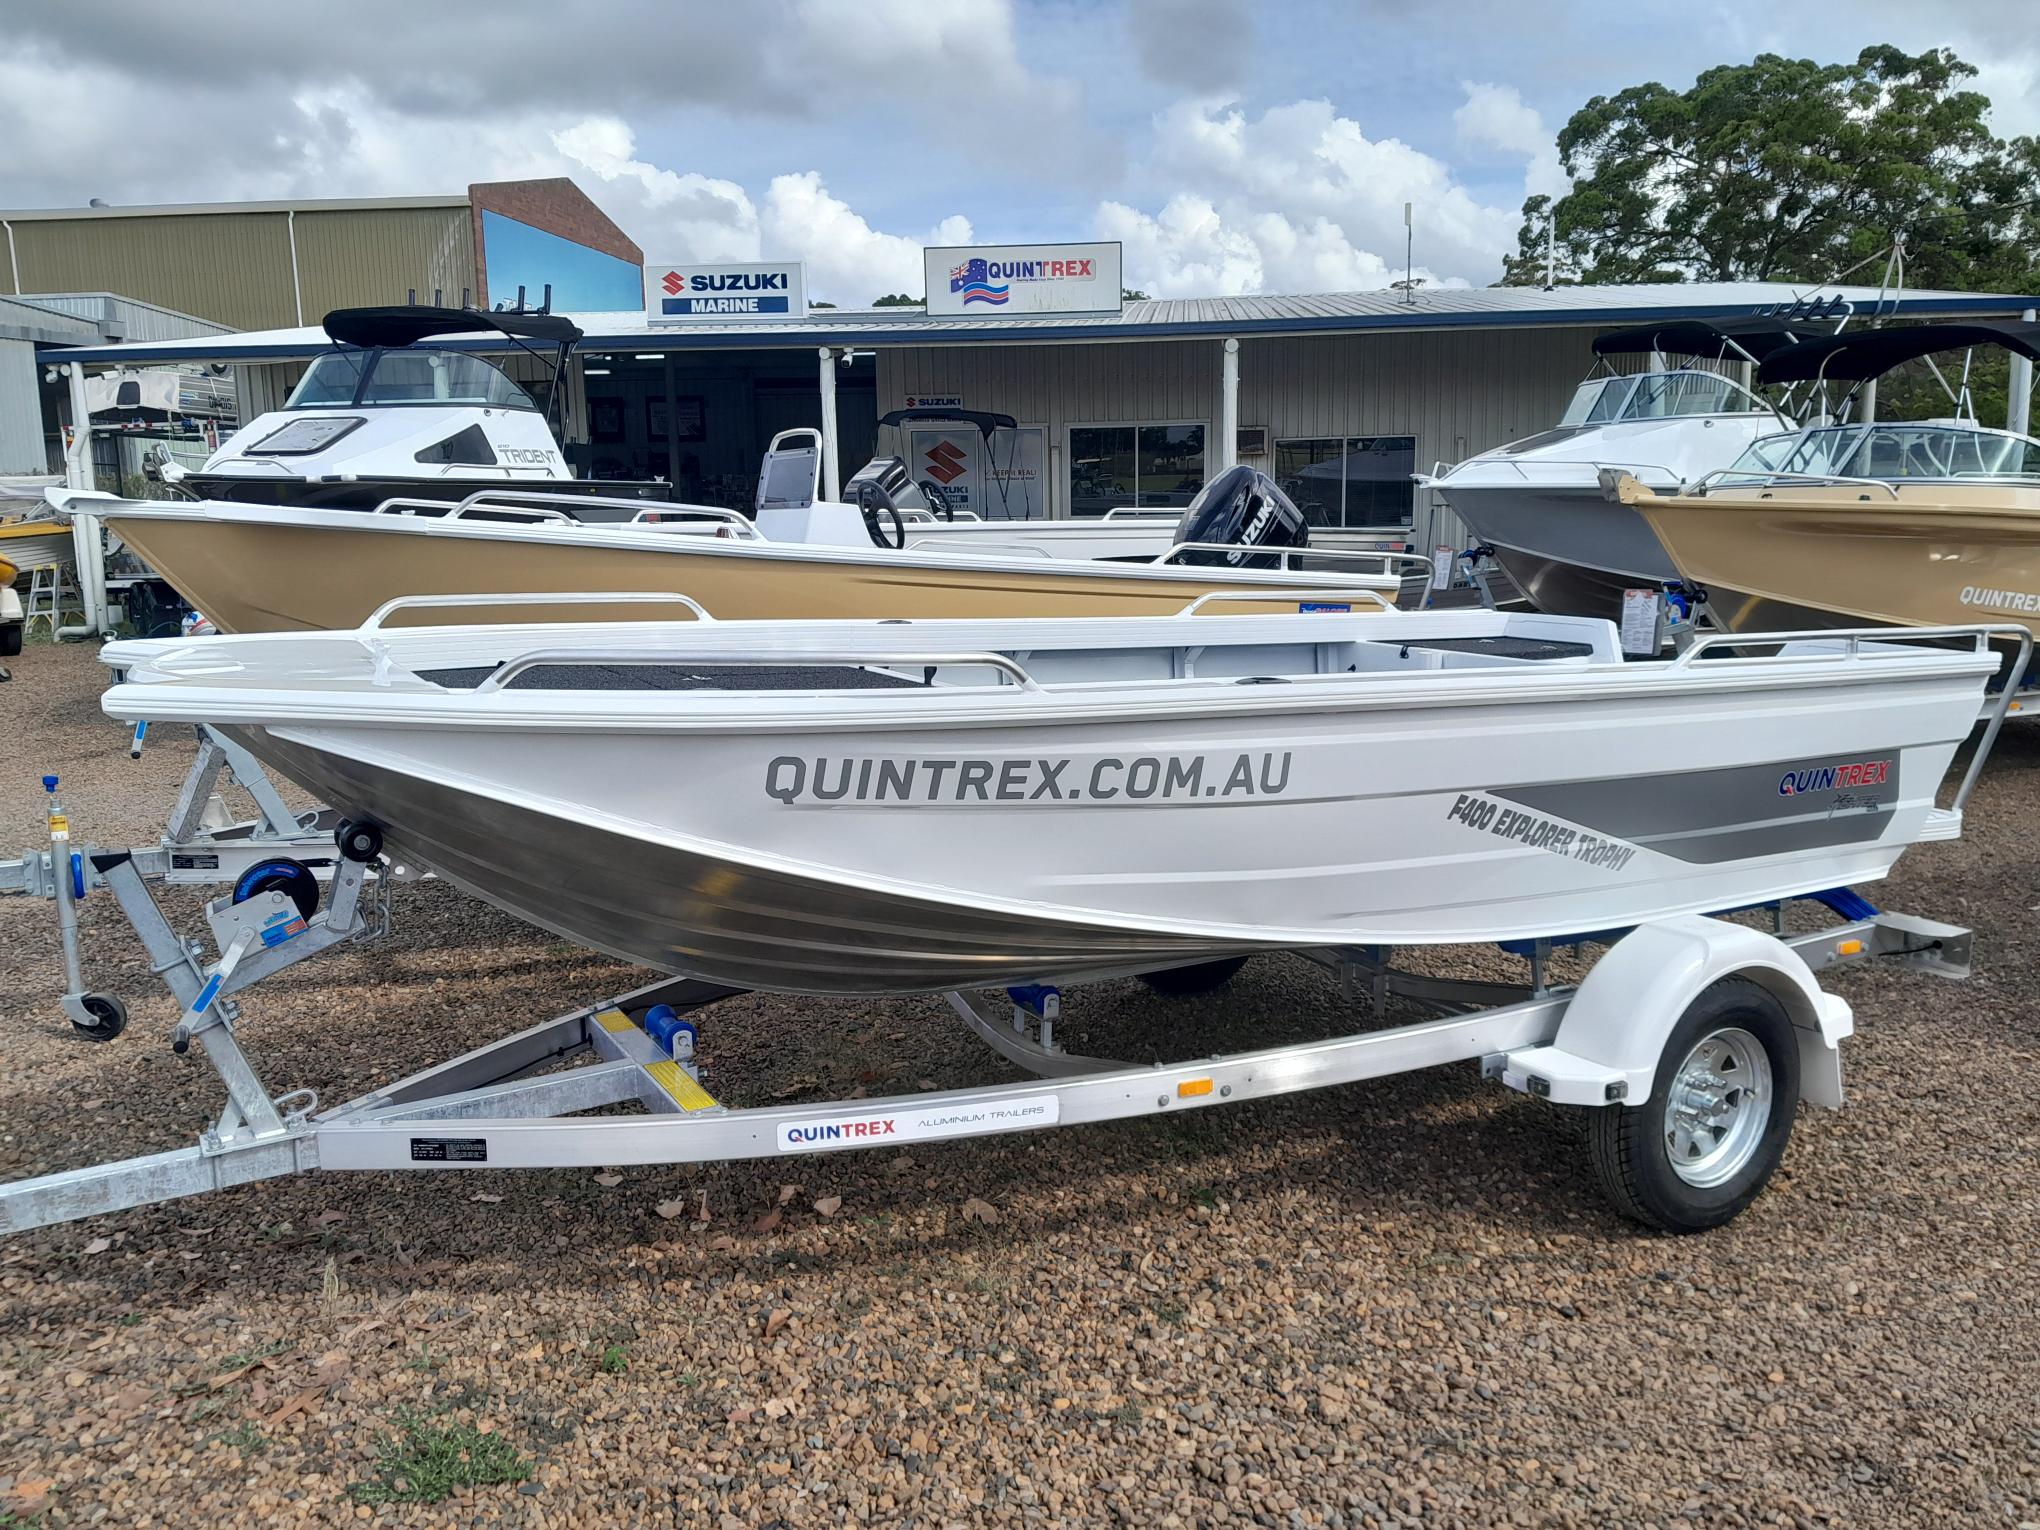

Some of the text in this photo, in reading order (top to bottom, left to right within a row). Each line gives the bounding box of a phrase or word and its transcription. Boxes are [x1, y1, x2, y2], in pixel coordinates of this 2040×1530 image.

[988, 260, 1092, 279] QUINTREX
[690, 273, 788, 291] SUZUKI
[691, 298, 759, 313] MARINE
[918, 398, 961, 406] SUZUKI
[499, 448, 556, 464] TRIDENT
[929, 486, 968, 494] UZUKI
[764, 752, 1292, 805] QUINTREX.COM.AU
[1778, 760, 1891, 797] QUINTREX
[1447, 794, 1637, 872] F400 EXPLORER TROPHY
[787, 1106, 1045, 1143] QUINTREX ALUMINIUM TRAILERS
